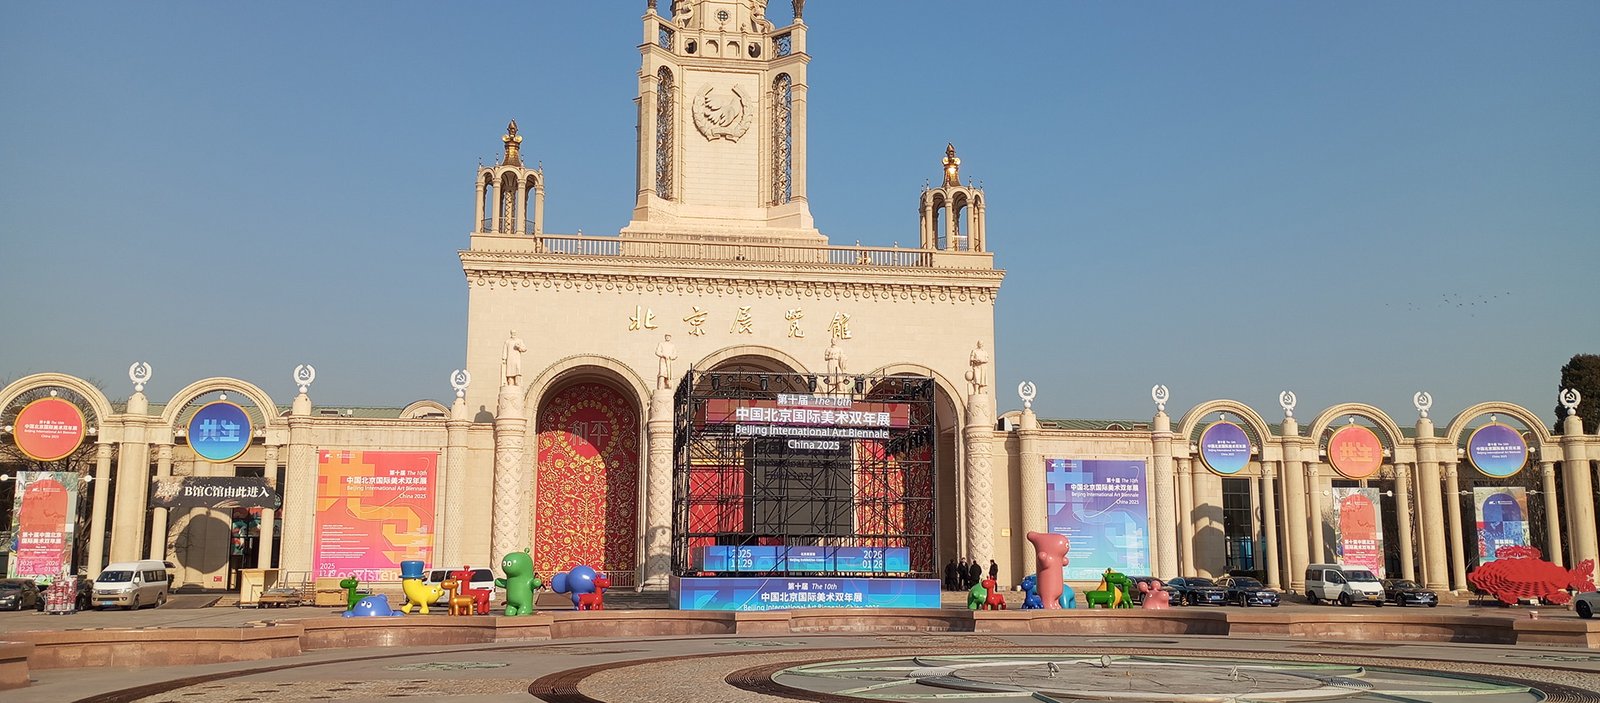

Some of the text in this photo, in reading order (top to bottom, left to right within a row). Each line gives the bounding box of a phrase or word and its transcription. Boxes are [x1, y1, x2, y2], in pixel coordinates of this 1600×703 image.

[778, 394, 808, 405] 第十届
[814, 396, 831, 405] The
[735, 406, 891, 427] 中国北京国际美术双年展
[568, 420, 609, 446] 和平
[735, 424, 889, 439] Beijing International Art Biennale
[787, 439, 840, 451] China 2025
[346, 477, 427, 485] 中国北京国际美术双年展
[184, 486, 270, 498] B馆C馆由此进入
[787, 582, 809, 590] 第十届
[761, 592, 863, 603] 中国北京国际美术双年展
